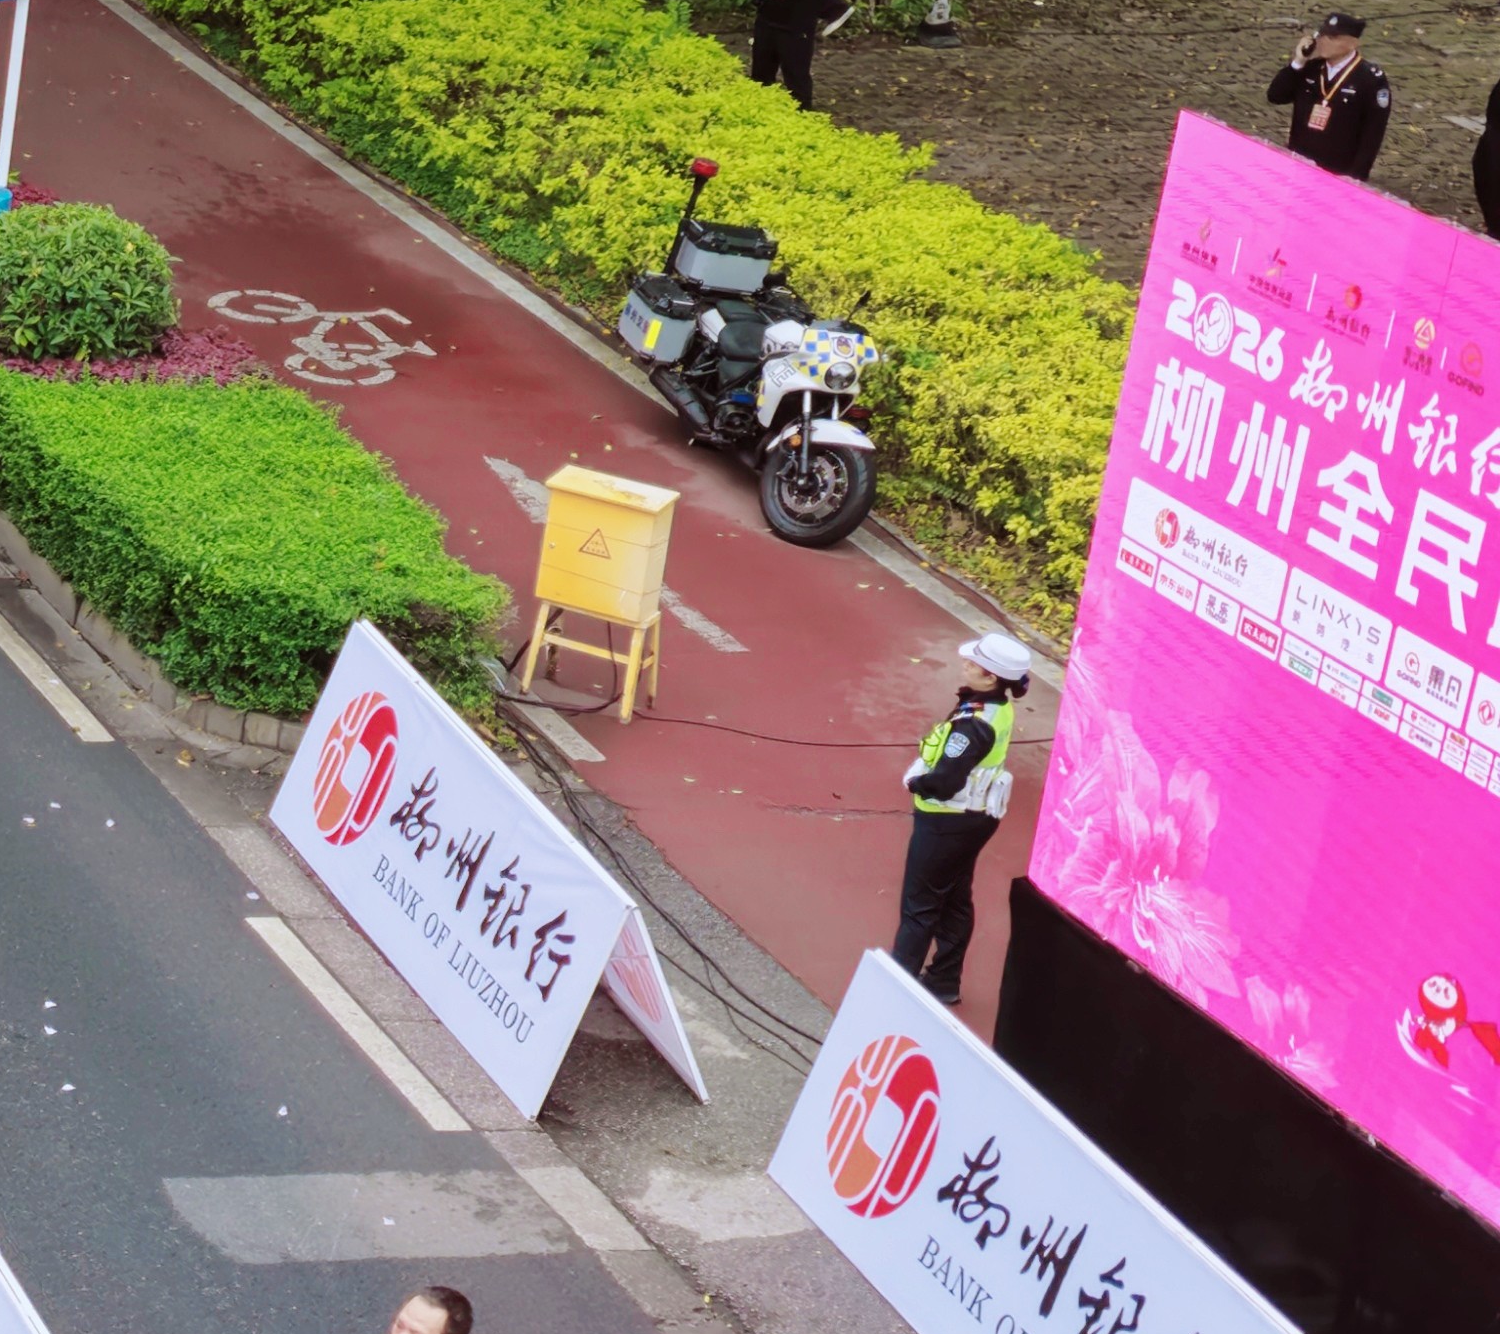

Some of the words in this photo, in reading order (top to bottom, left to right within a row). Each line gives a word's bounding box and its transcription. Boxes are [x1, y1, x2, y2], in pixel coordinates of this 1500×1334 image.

[1141, 356, 1500, 647] 柳州全民
[372, 855, 423, 923] BANK
[423, 913, 449, 944] OF
[449, 941, 534, 1044] LIUZHOU
[390, 766, 576, 1004] 柳州银行
[918, 1234, 993, 1323] BANK
